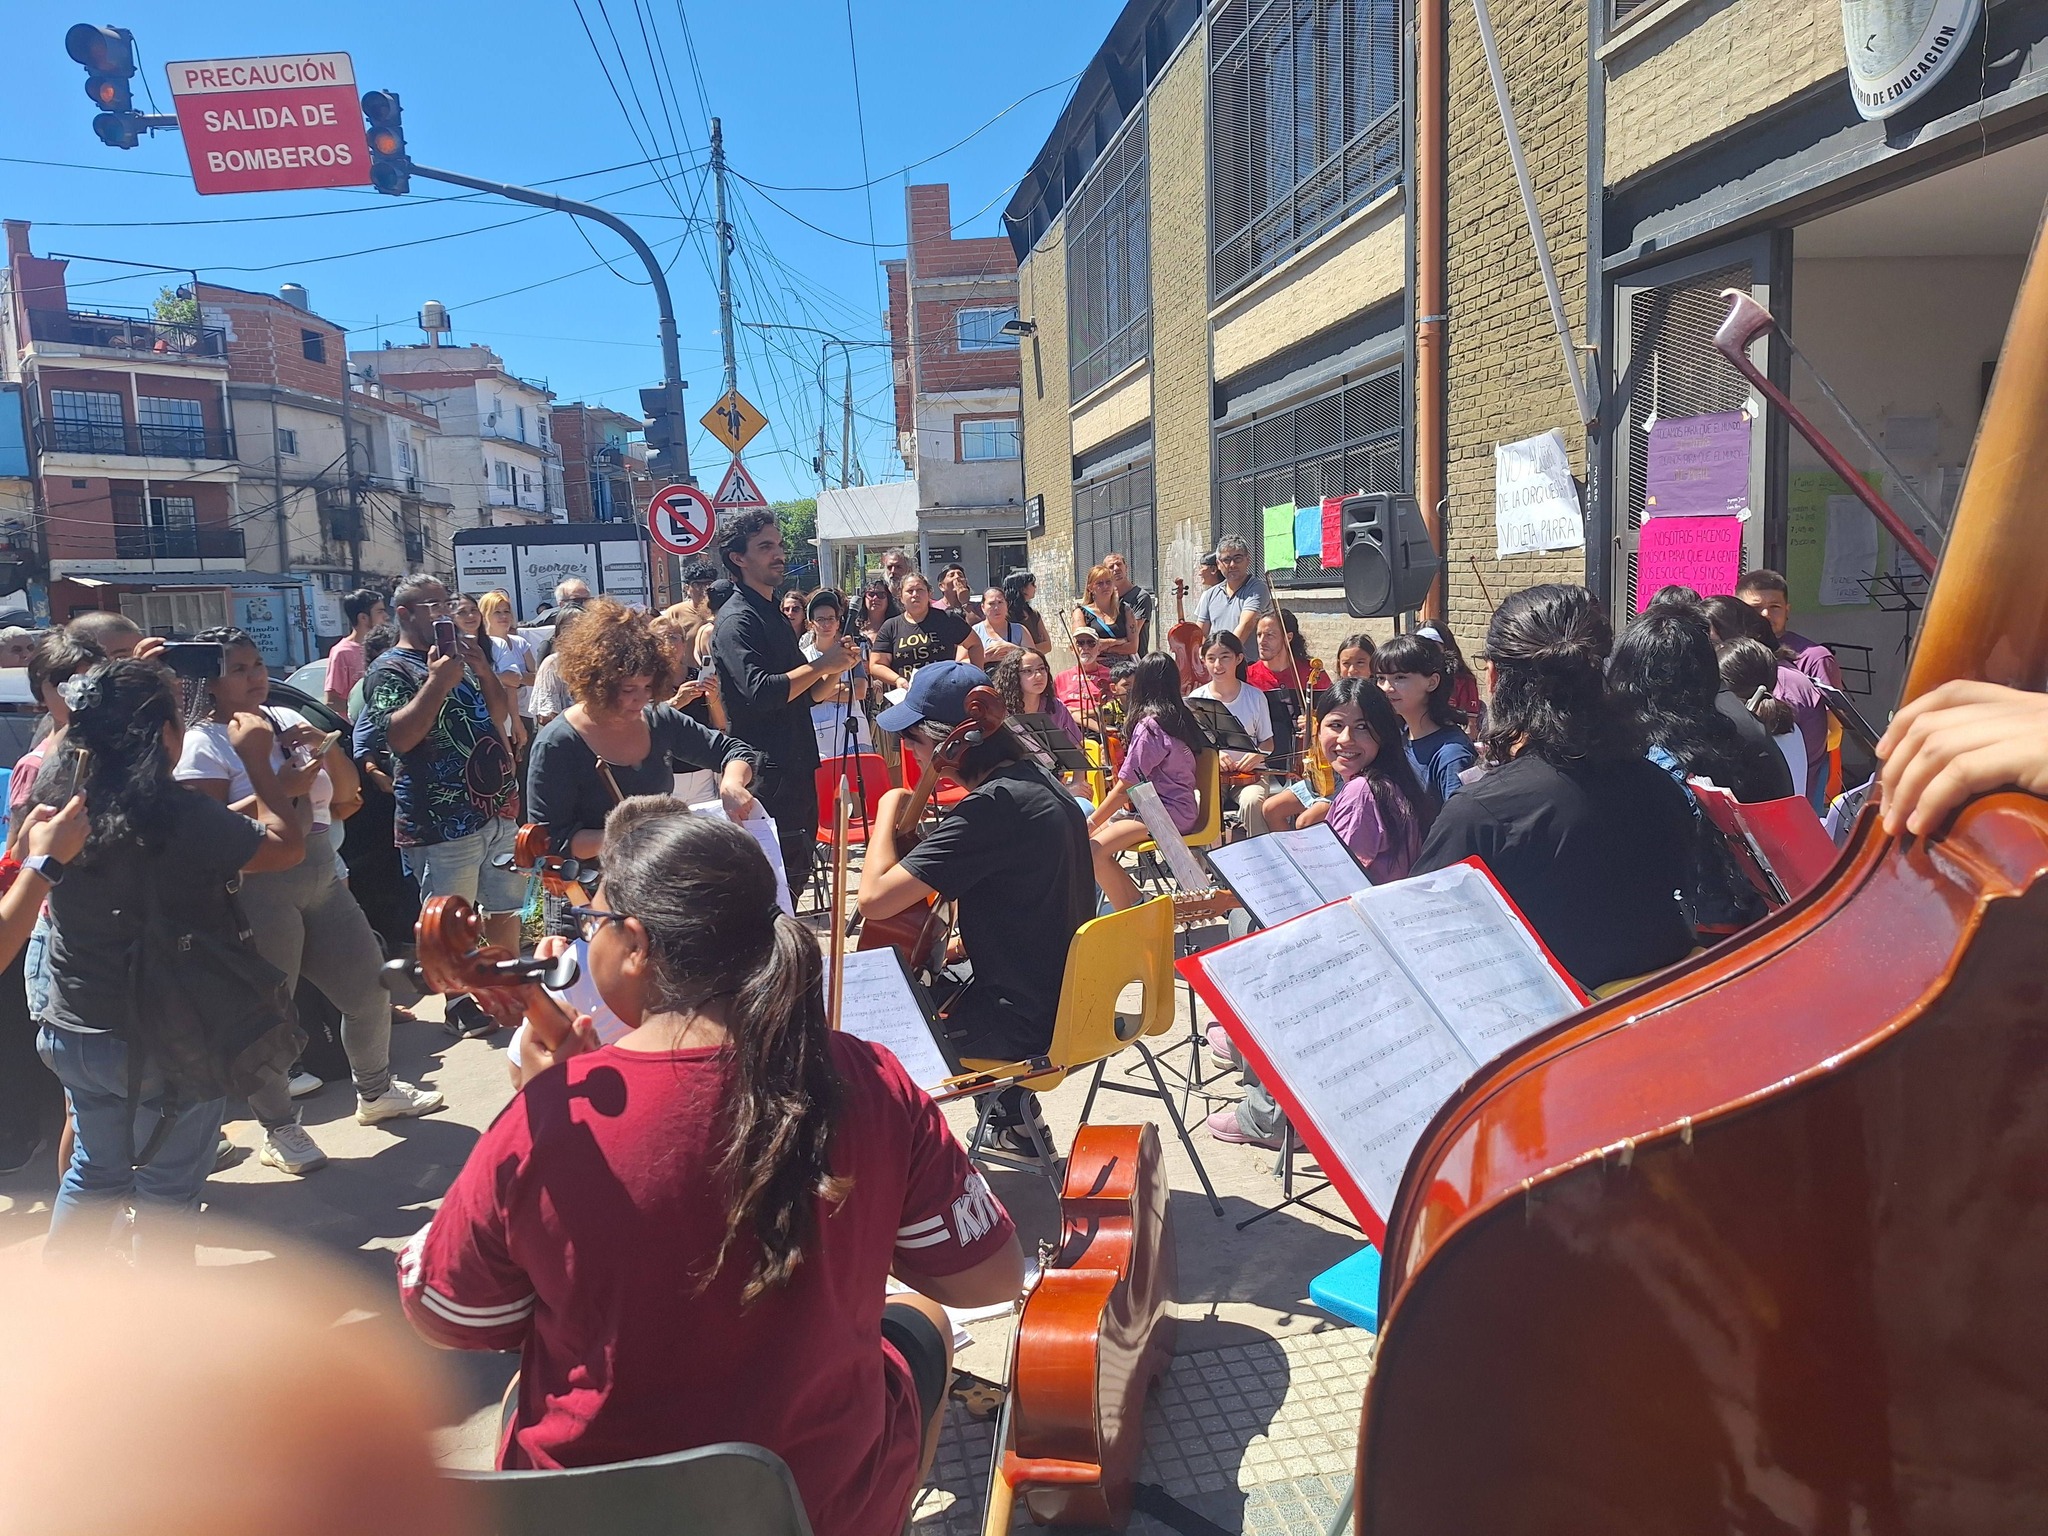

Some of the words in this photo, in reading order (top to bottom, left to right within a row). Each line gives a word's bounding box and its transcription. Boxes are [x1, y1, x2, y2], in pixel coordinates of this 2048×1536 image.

[185, 58, 337, 88] PRECAUCIÓN
[1873, 91, 1886, 106] DE
[1887, 25, 1956, 101] EDUCACIÓN
[204, 106, 298, 132] SALIDA
[302, 104, 337, 127] DE
[207, 144, 352, 173] BOMBEROS
[1500, 449, 1521, 485] NO
[1499, 492, 1511, 513] DE
[1512, 490, 1520, 509] LA
[668, 498, 692, 535] E
[1541, 517, 1576, 542] PARRA
[1654, 530, 1693, 546] NOSOTROS
[1696, 529, 1731, 543] HACEMOS
[1669, 550, 1685, 562] PARA
[1687, 549, 1703, 565] QUE
[1705, 550, 1716, 562] LA
[1717, 550, 1738, 563] GENTE
[529, 563, 587, 577] George's
[1696, 583, 1733, 596] TOCAMOS
[899, 632, 940, 648] LOVE
[912, 647, 929, 660] IS
[903, 660, 936, 678] RE
